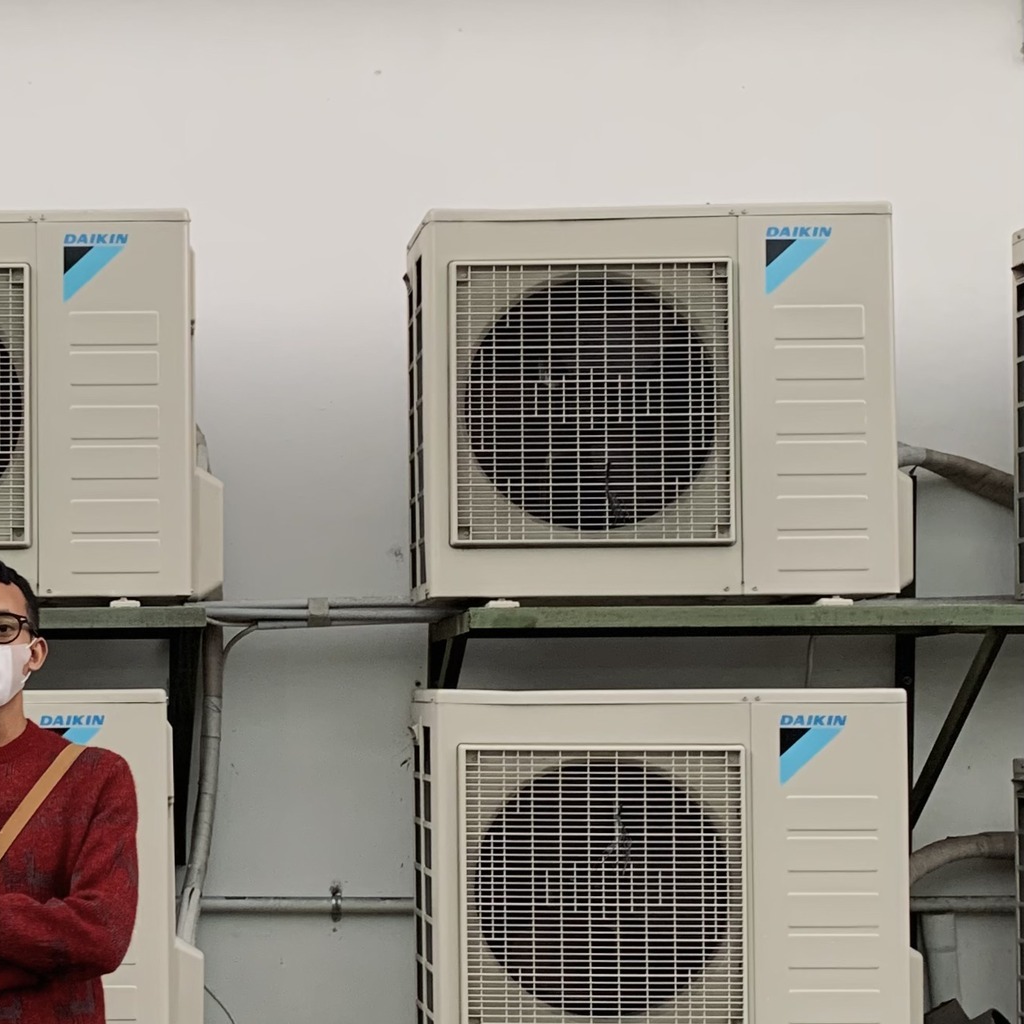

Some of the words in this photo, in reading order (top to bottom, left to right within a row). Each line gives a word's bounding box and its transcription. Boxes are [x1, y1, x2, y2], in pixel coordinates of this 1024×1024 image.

[766, 227, 832, 237] DAIKIN
[64, 234, 128, 245] DAIKIN
[40, 715, 105, 726] DAIKIN
[780, 715, 847, 726] DAIKIN
